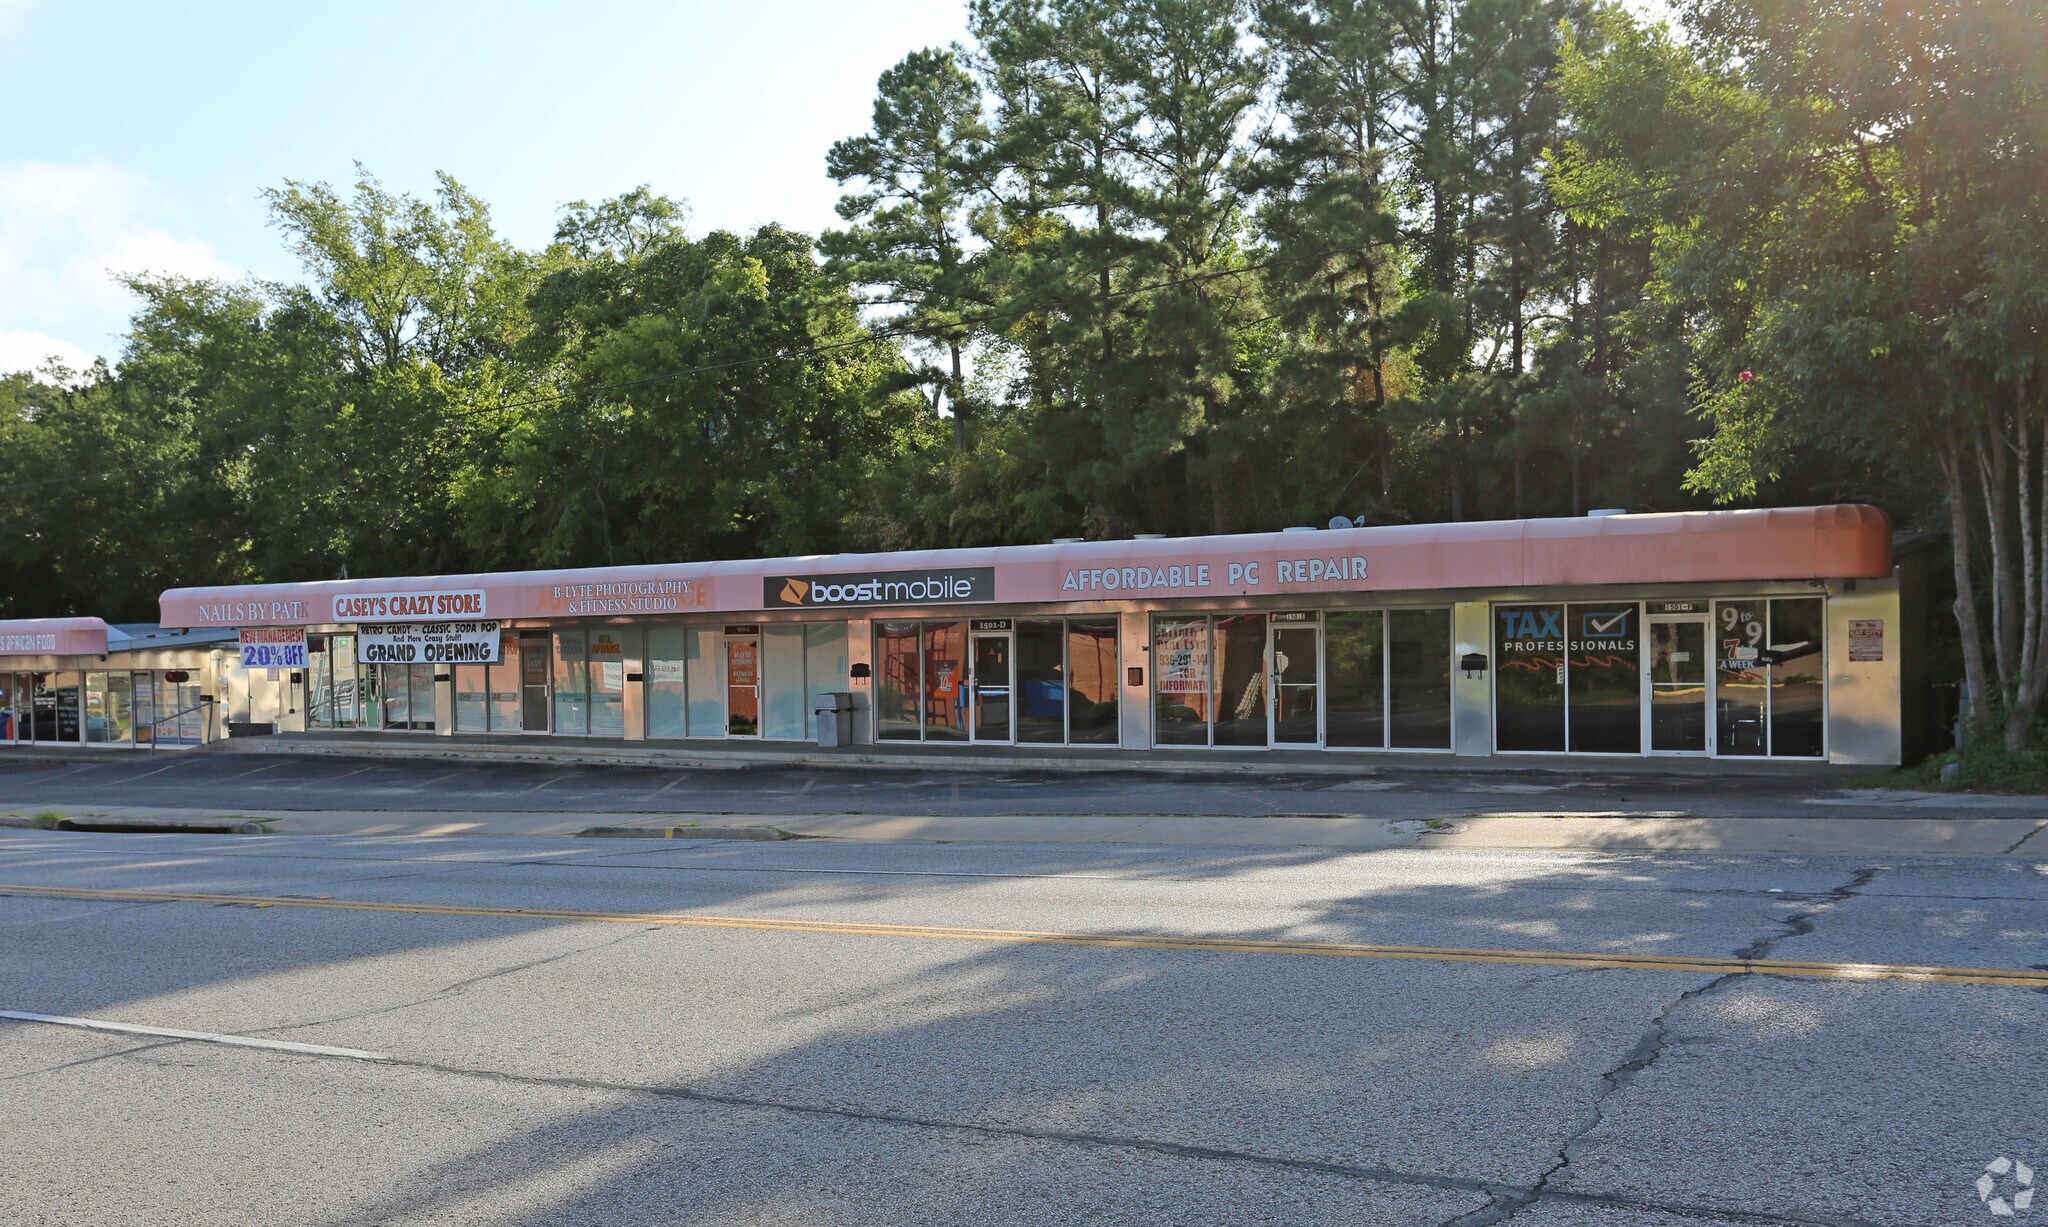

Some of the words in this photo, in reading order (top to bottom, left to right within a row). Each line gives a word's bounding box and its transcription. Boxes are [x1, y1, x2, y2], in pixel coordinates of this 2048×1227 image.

[1062, 564, 1211, 591] AFFORDABLE
[1227, 561, 1259, 586] PC
[1276, 556, 1368, 584] REPAIR
[554, 584, 593, 599] B-LYTE
[596, 580, 690, 596] PHOTOGRAPHY
[199, 602, 245, 622] NAILS
[248, 602, 267, 620] BY
[335, 597, 387, 617] CASEY'S
[389, 595, 435, 616] CRAZY
[437, 594, 482, 614] STORE
[568, 601, 578, 613] &
[580, 598, 627, 613] FITNESS
[628, 597, 678, 611] STUDIO
[361, 625, 383, 635] RETRO
[386, 625, 411, 635] CANDY
[422, 623, 451, 634] CLASSIC
[455, 623, 477, 633] SODA
[480, 622, 497, 633] POP
[979, 621, 1006, 629] 1501-D
[1500, 610, 1563, 639] TAX
[1721, 607, 1738, 631] 9
[1740, 611, 1754, 623] to
[36, 633, 56, 651] FOOD
[240, 629, 256, 643] NEW
[256, 629, 304, 643] MANAGEMENT
[424, 635, 443, 643] Crazy
[445, 634, 462, 642] Stuff!
[1745, 621, 1763, 645] 9
[243, 645, 282, 666] 20%
[284, 645, 303, 666] OFF
[366, 643, 416, 662] GRAND
[424, 642, 491, 661] OPENING
[1723, 638, 1740, 660] 7
[1720, 660, 1727, 668] A
[1729, 659, 1756, 669] WEEK
